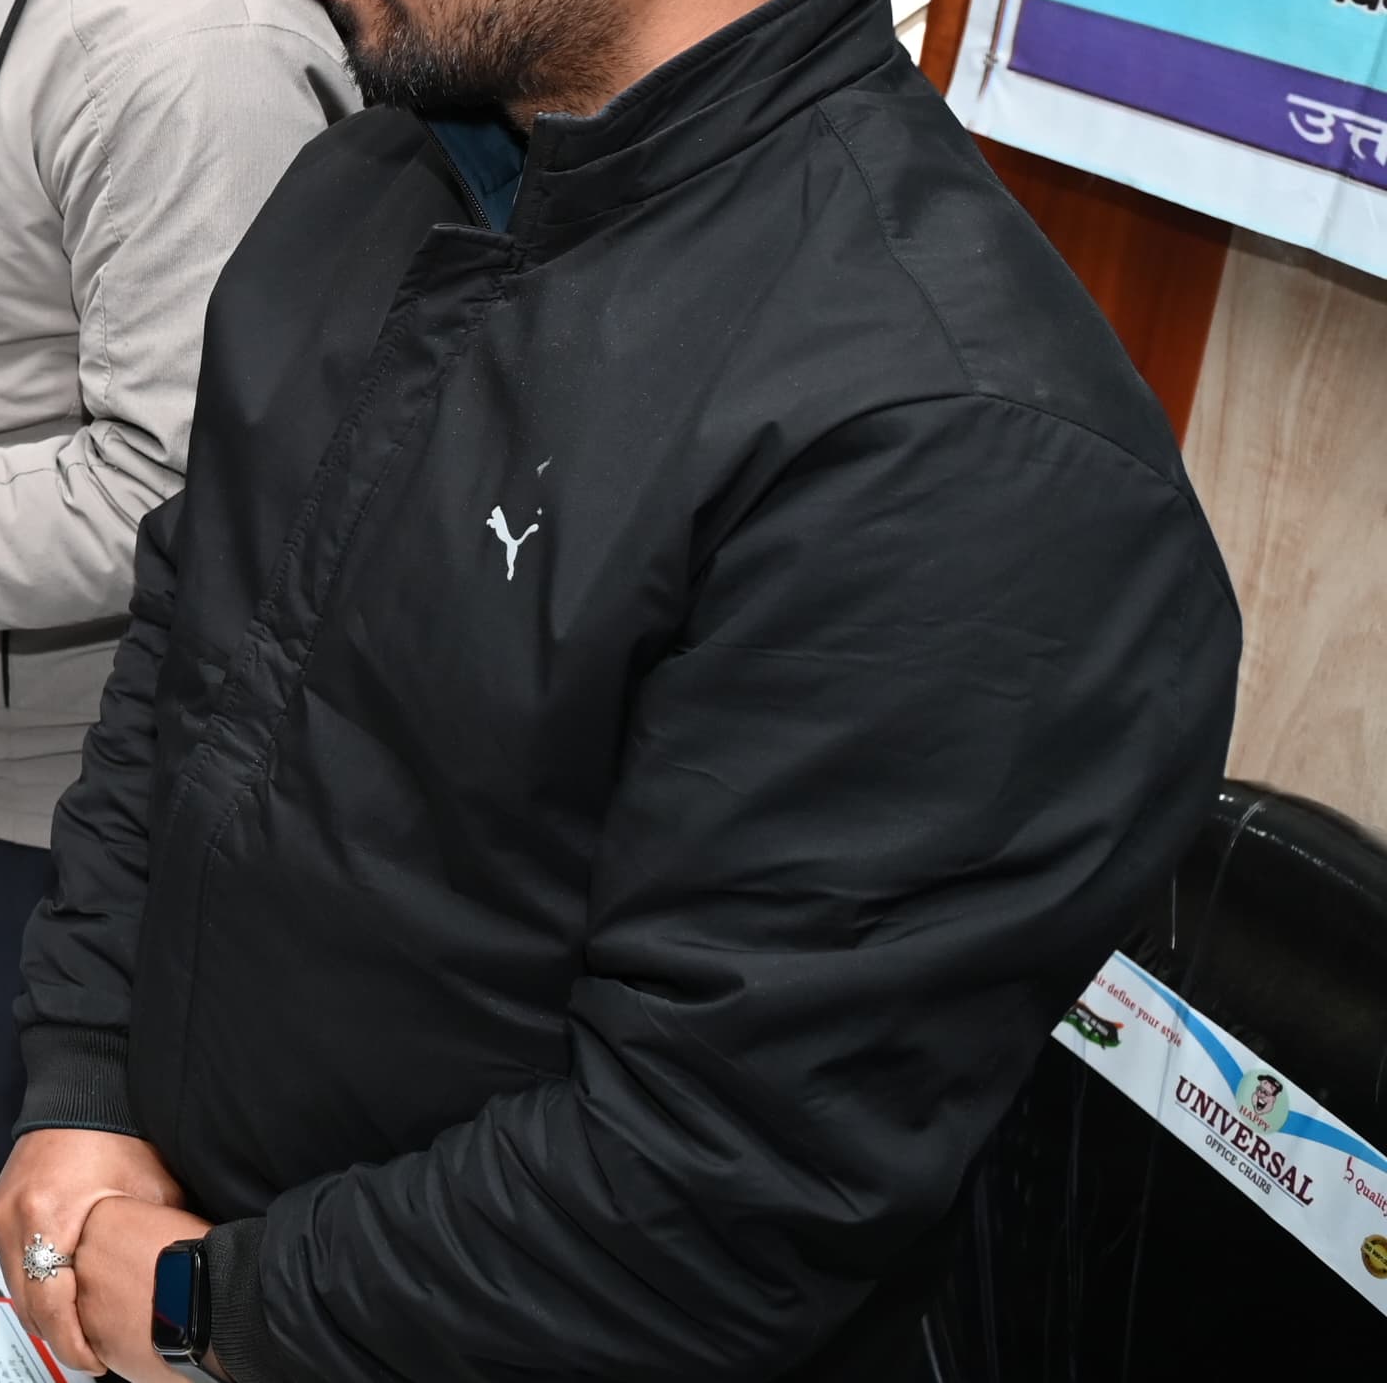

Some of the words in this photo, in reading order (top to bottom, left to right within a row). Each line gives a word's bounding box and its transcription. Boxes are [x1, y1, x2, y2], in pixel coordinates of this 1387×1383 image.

[1287, 93, 1387, 168] उत्त
[1107, 983, 1136, 1011] define
[1135, 1007, 1160, 1029] your
[1161, 1024, 1182, 1048] style
[1175, 1075, 1314, 1206] UNIVERSAL
[1238, 1105, 1271, 1132] HAPPY
[1205, 1134, 1237, 1166] OFFICE
[1237, 1161, 1272, 1195] CHAIRS
